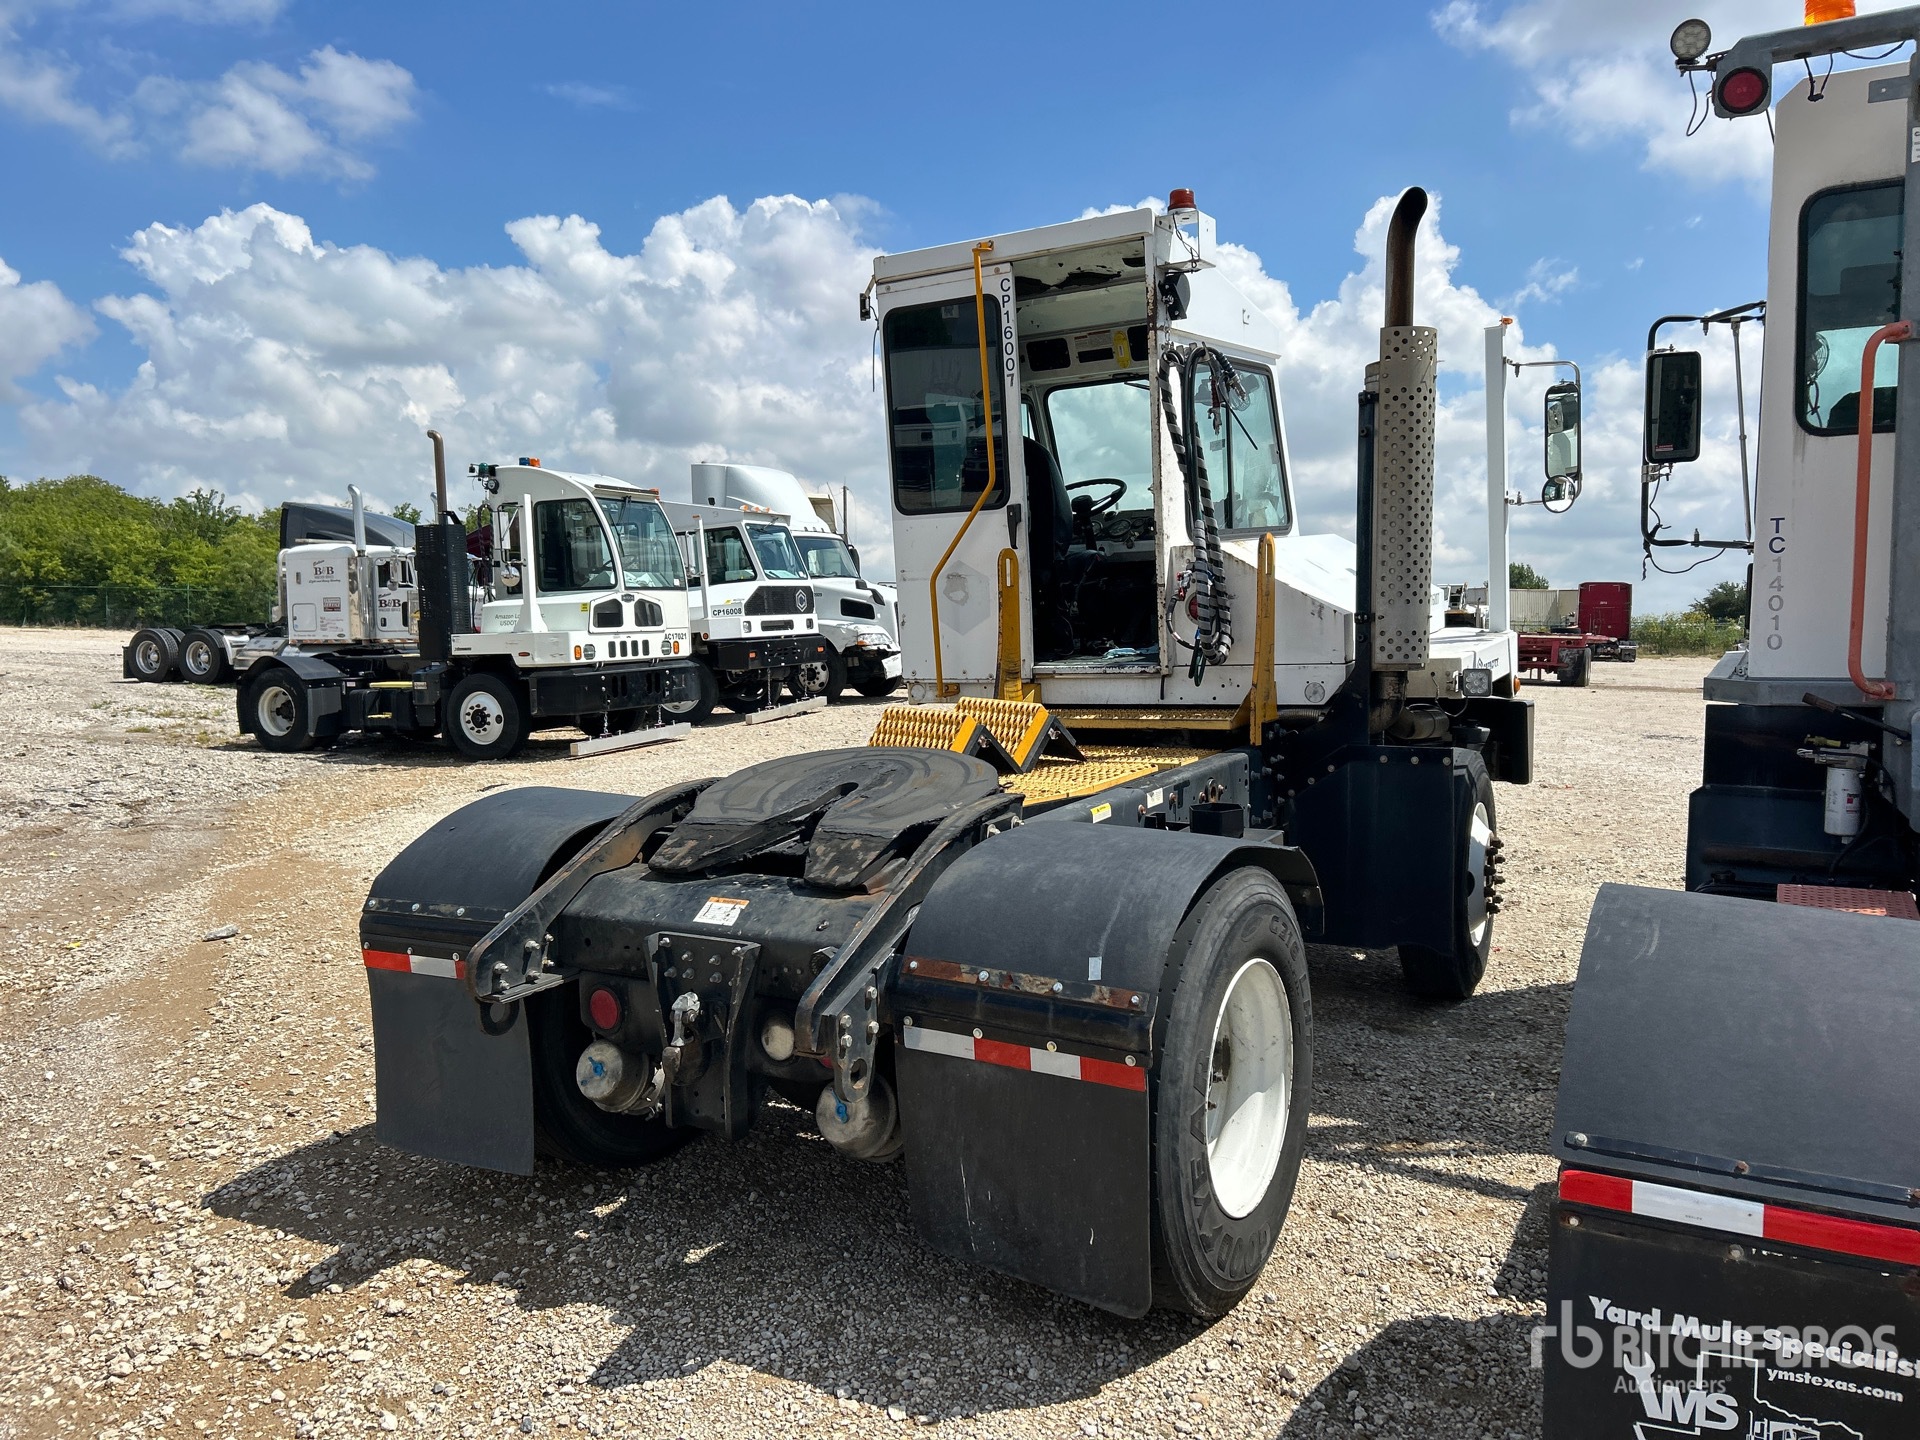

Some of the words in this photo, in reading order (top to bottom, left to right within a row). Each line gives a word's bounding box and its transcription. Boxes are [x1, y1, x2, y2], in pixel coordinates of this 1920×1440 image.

[1000, 278, 1015, 387] CP16007
[1766, 517, 1786, 651] TC14010
[1588, 1295, 1661, 1332] Yard
[1671, 1313, 1753, 1346] Mule
[1766, 1368, 1904, 1403] ymstexas.com
